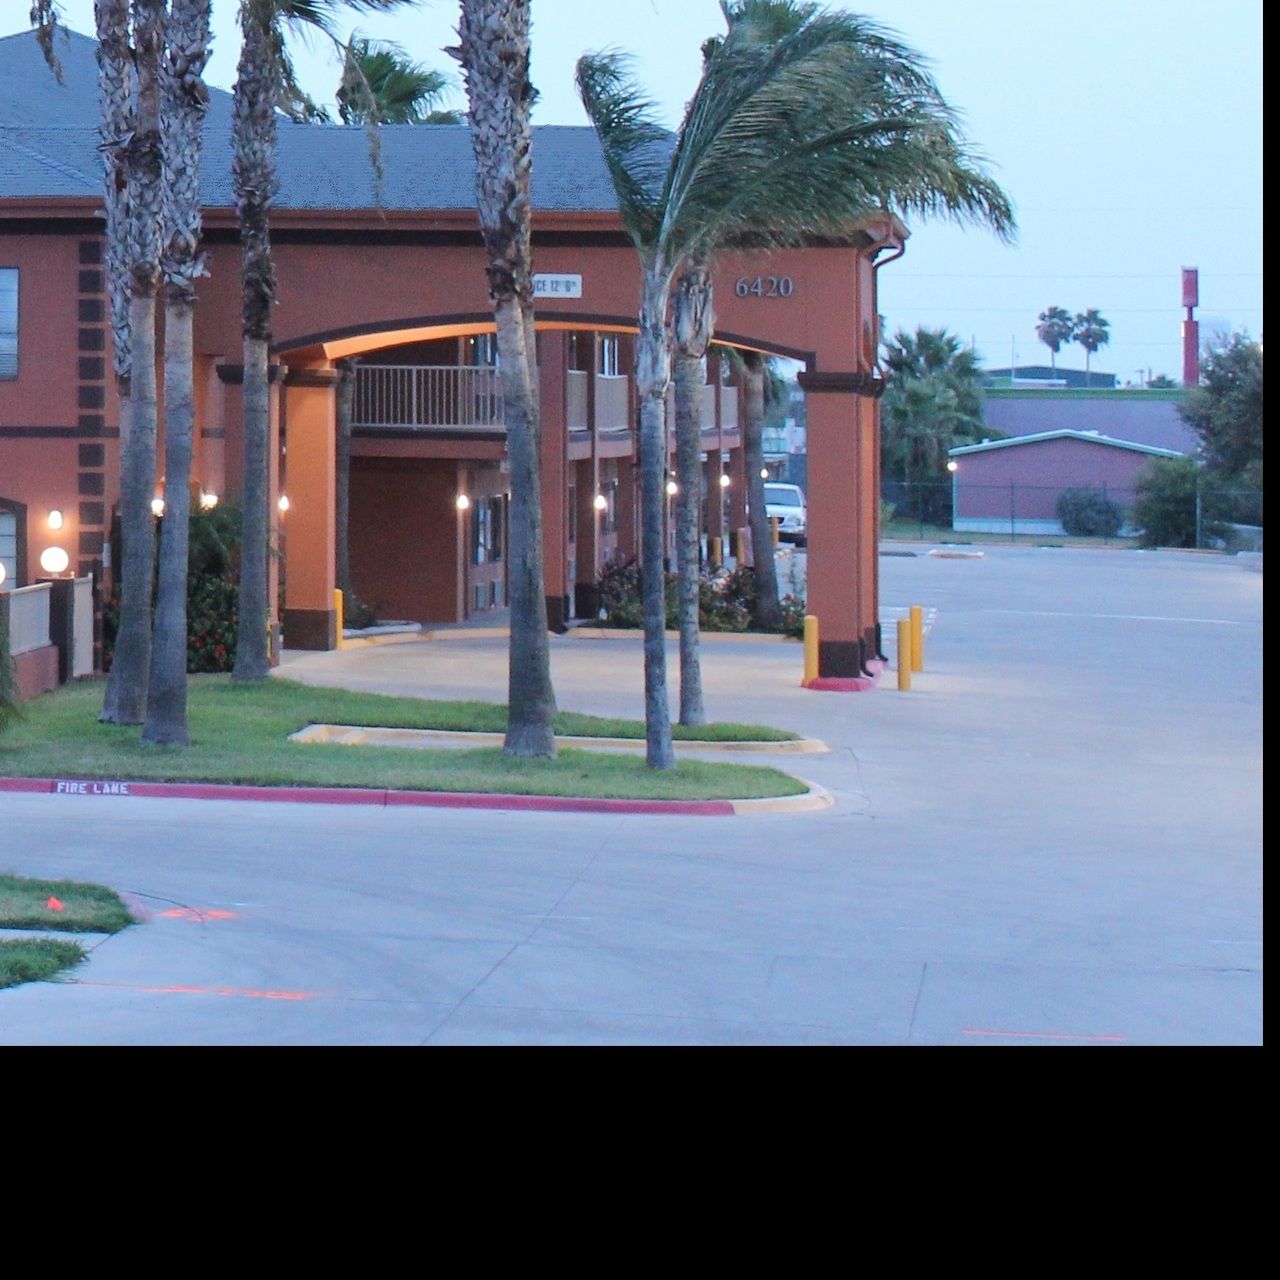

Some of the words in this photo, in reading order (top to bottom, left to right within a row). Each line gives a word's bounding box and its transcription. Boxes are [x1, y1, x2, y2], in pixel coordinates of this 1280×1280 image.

[735, 276, 794, 297] 6420
[57, 782, 87, 794] FIRE
[93, 783, 129, 794] LANE
